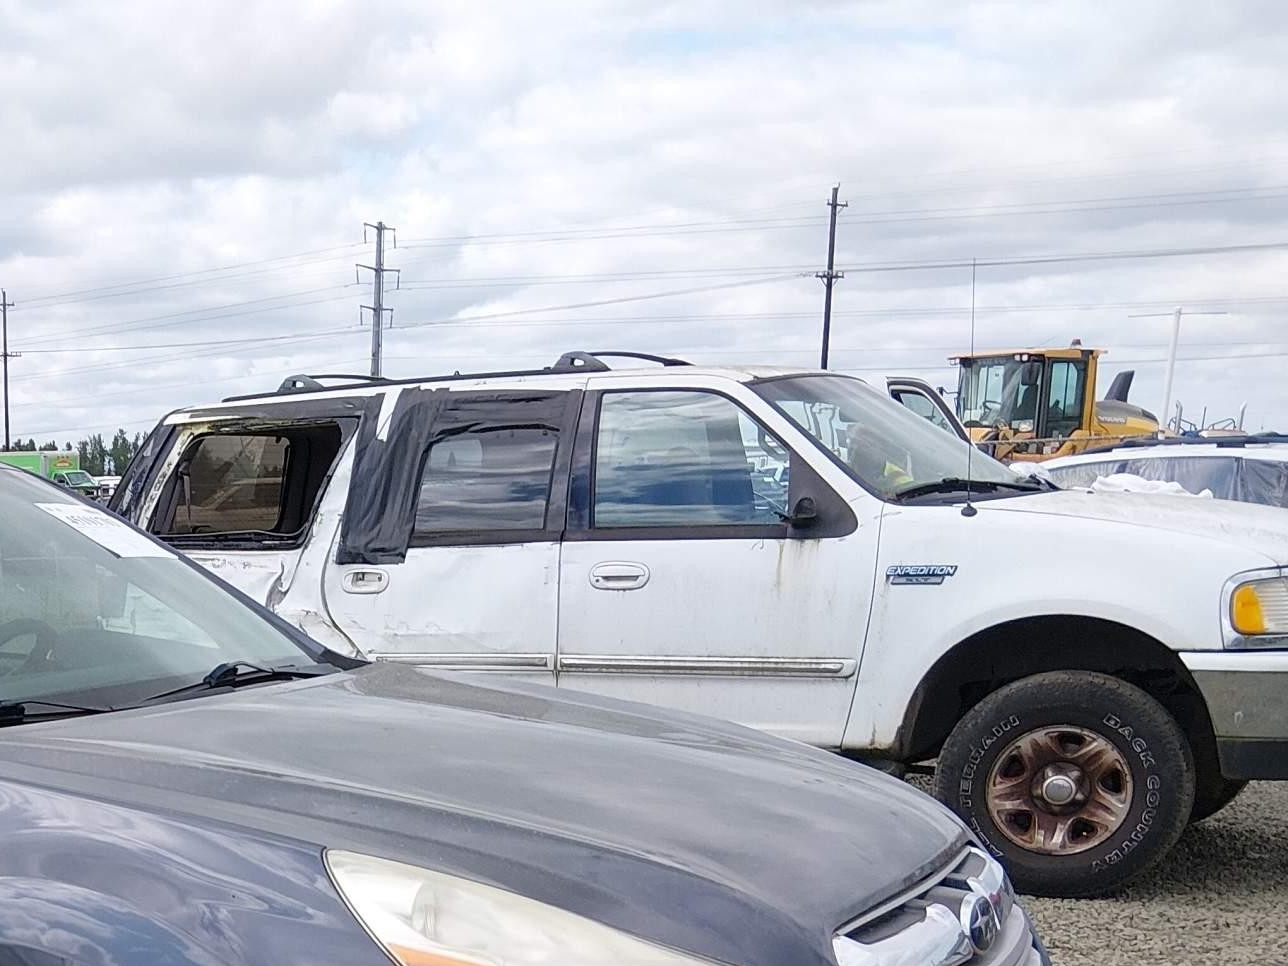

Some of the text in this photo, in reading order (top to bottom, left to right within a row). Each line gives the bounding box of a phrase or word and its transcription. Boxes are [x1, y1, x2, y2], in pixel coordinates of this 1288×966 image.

[886, 565, 956, 576] EXPEDITION
[1091, 712, 1161, 873] BACK COUNTRY
